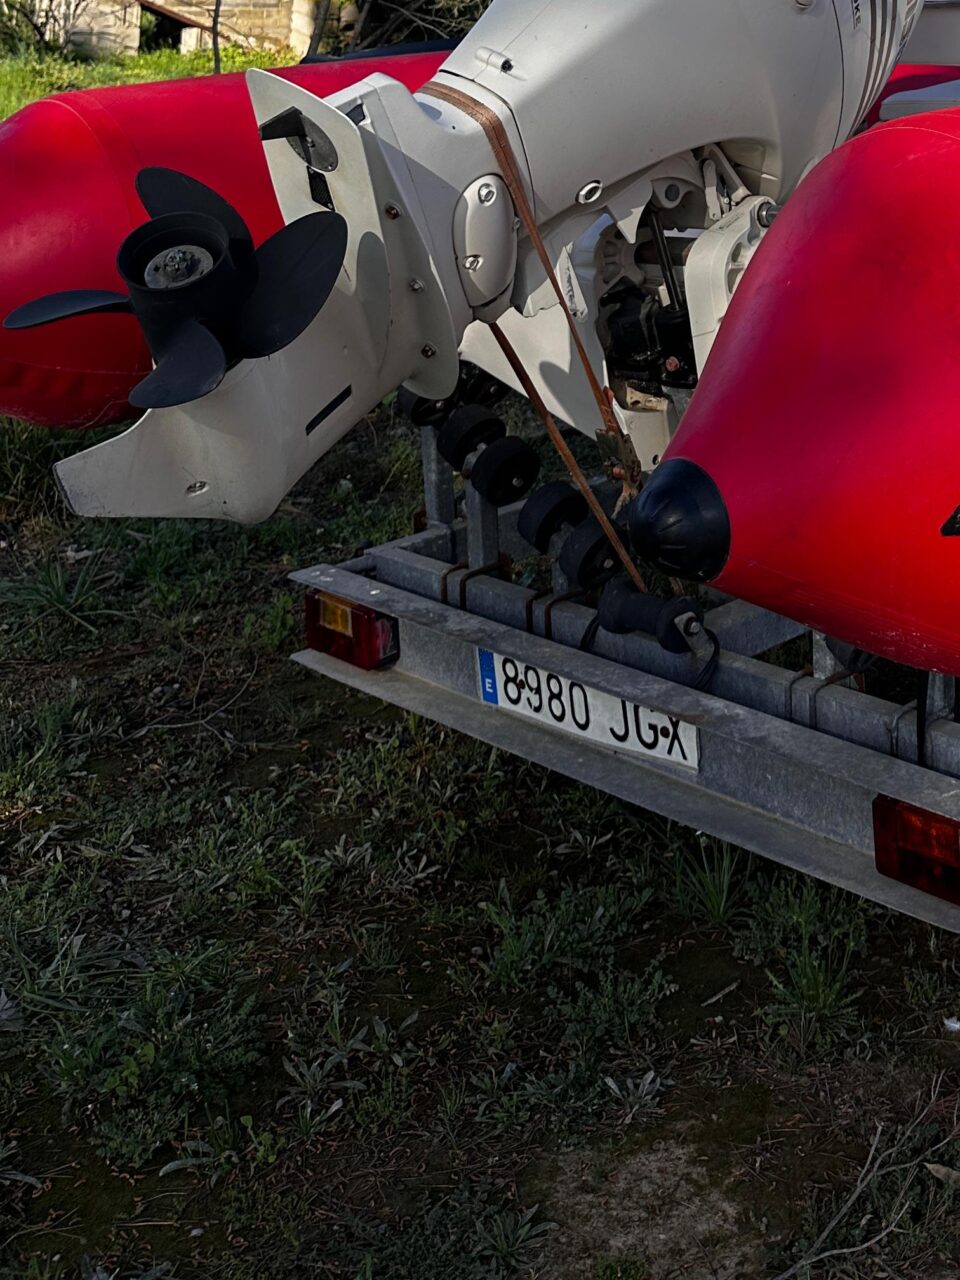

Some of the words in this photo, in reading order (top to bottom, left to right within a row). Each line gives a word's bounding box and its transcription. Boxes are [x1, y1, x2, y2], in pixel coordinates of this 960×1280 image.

[485, 678, 493, 693] E
[502, 657, 590, 731] 8980
[609, 699, 688, 761] JGX
